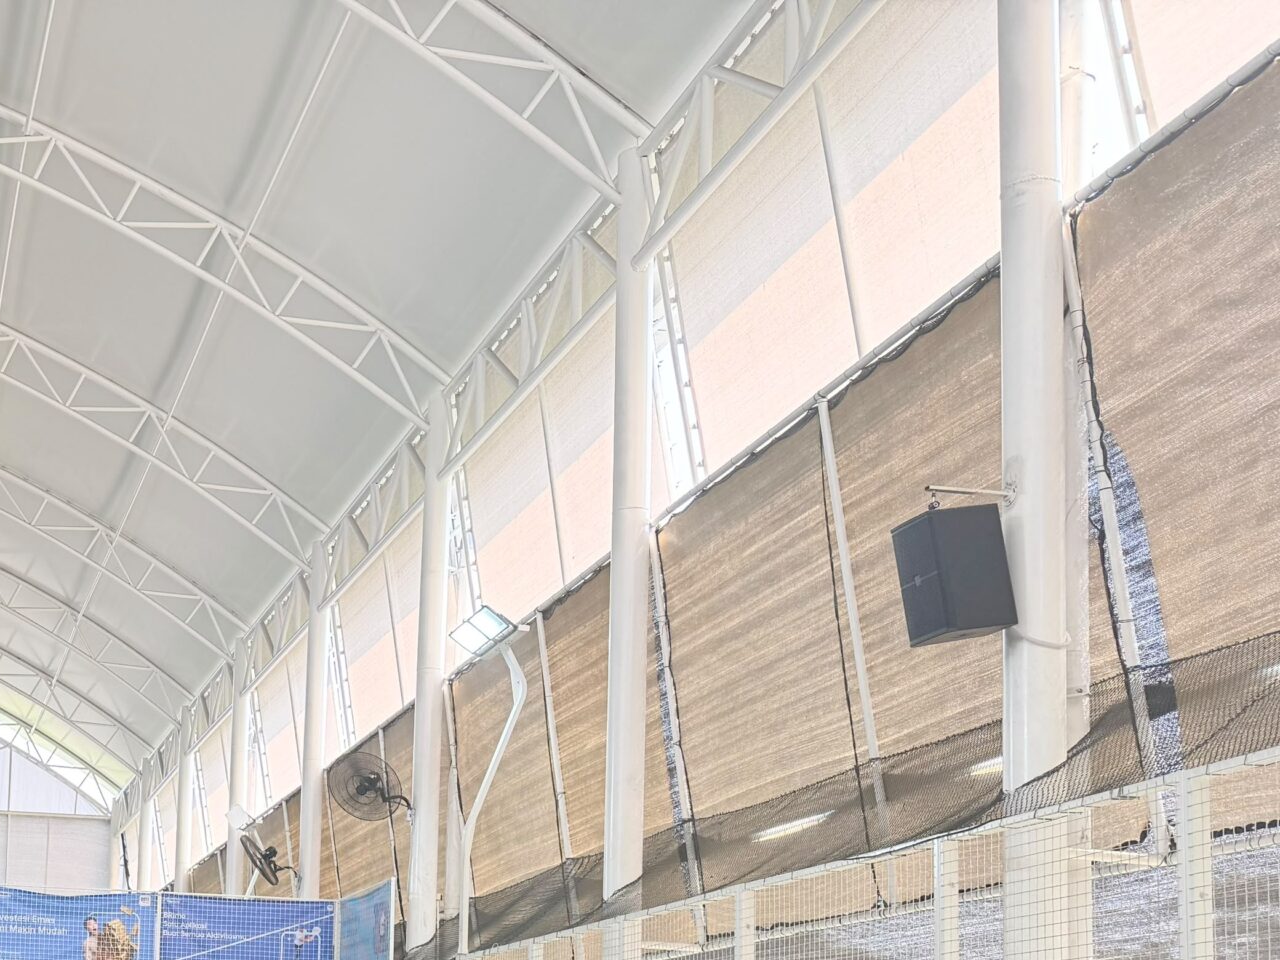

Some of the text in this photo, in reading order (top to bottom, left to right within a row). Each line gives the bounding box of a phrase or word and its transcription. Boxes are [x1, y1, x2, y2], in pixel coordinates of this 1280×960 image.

[32, 915, 55, 924] Emas
[10, 925, 36, 933] Makin
[38, 927, 68, 935] Mudah
